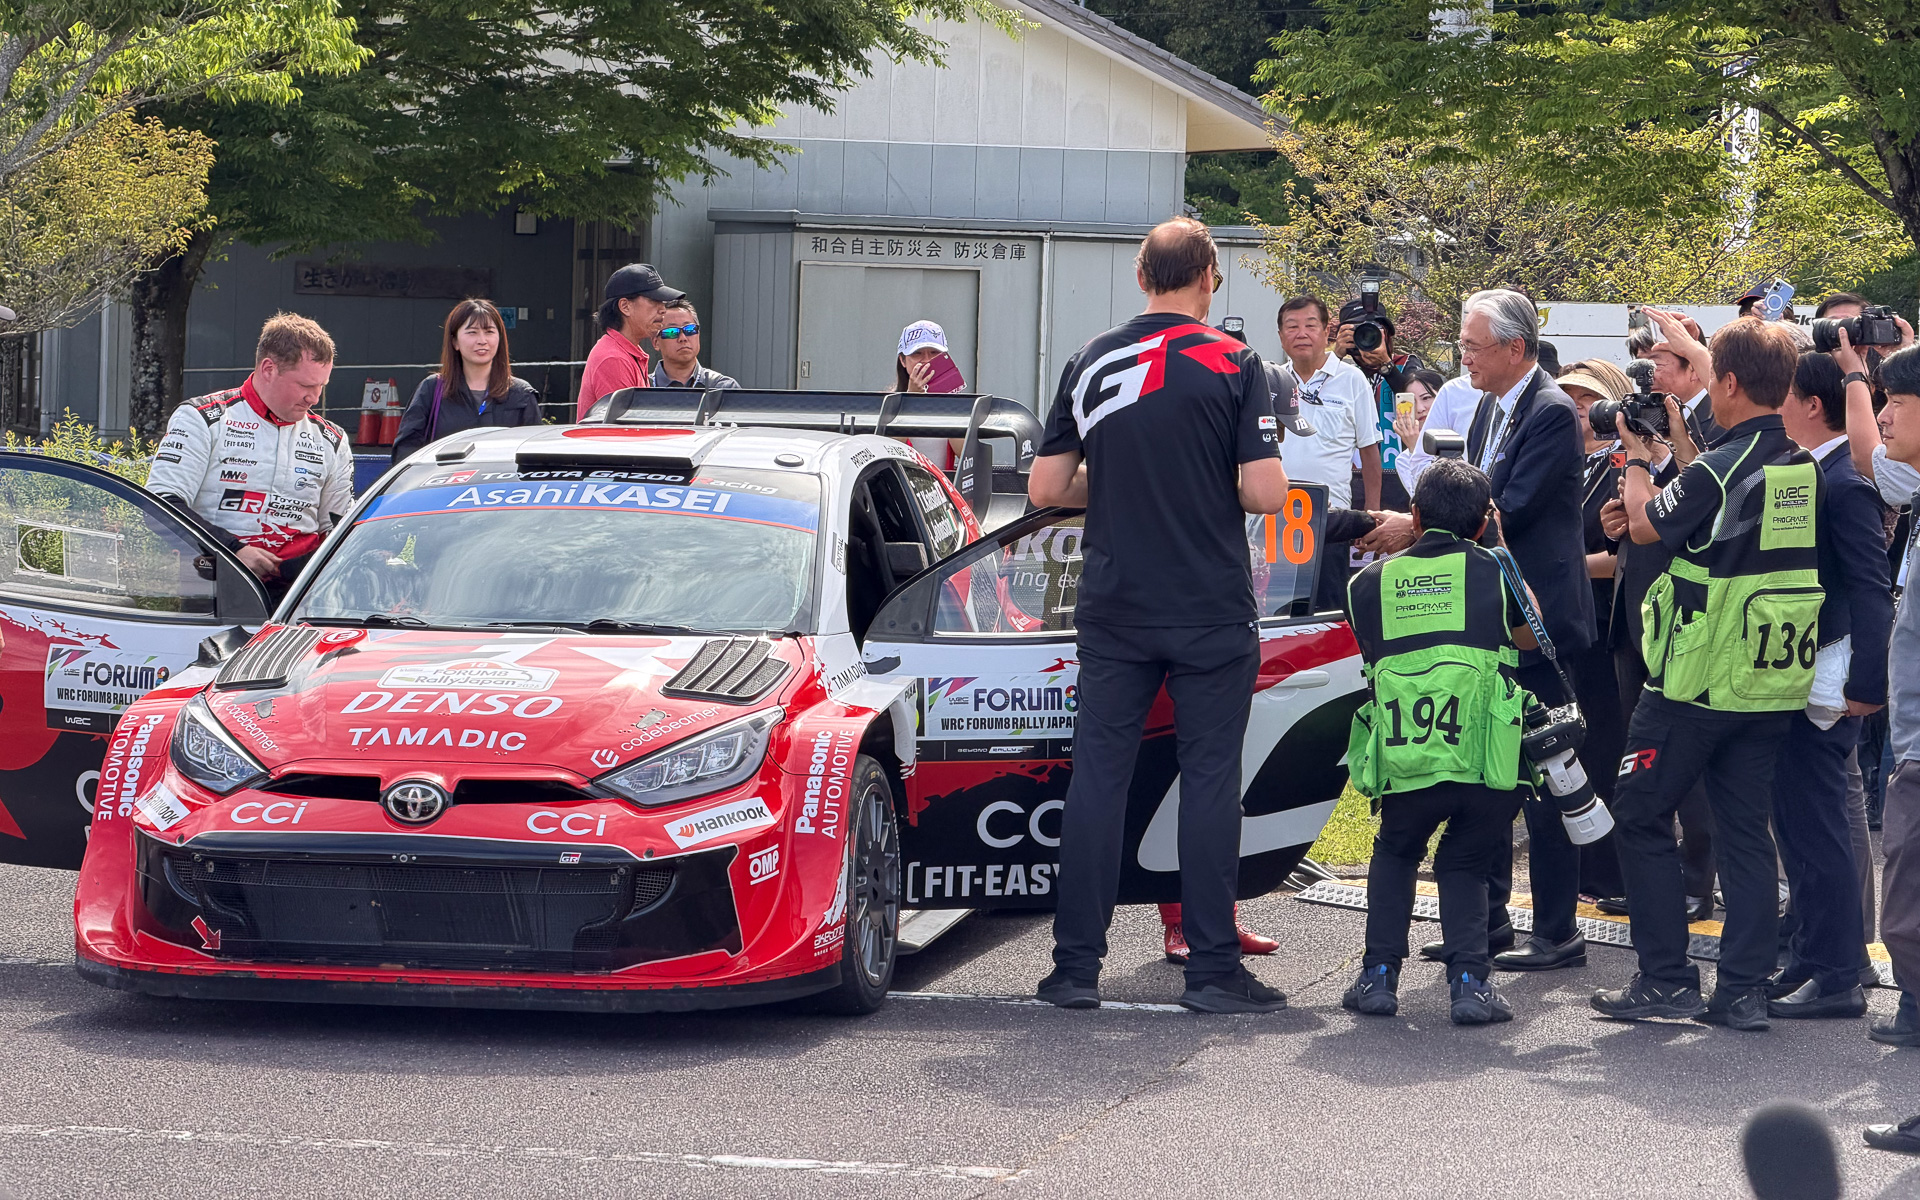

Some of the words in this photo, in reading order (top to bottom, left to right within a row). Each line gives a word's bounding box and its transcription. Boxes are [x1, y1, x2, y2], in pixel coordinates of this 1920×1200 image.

[811, 236, 942, 258] 和合自主防災会
[954, 241, 1027, 261] 防災倉庫
[1071, 323, 1249, 443] GR
[225, 419, 260, 430] DENSO
[226, 426, 255, 436] Panasonic
[1294, 417, 1309, 431] 18
[422, 473, 474, 487] GR
[481, 470, 583, 481] TOYOTA
[588, 470, 685, 483] GAZOO
[689, 477, 778, 495] Racing
[1774, 485, 1810, 500] WRC
[220, 497, 263, 513] GR
[265, 508, 303, 521] Racing
[272, 494, 312, 509] TOYOTA
[1264, 488, 1314, 565] 18
[1395, 573, 1452, 589] WRC
[1753, 621, 1816, 670] 136
[83, 661, 170, 691] FORUM8
[432, 668, 510, 677] FORUM8
[831, 660, 867, 691] TAMADIC
[57, 687, 76, 701] WRC
[77, 689, 112, 704] FORUM8
[112, 693, 141, 706] RALLY
[339, 691, 564, 719] DENSO
[973, 684, 1079, 713] FORUM8
[64, 716, 92, 726] WRC
[225, 703, 280, 752] codebeamer
[621, 705, 721, 752] codebeamer
[941, 717, 964, 731] WRC
[966, 717, 1011, 731] FORUM8
[1013, 717, 1046, 730] RALLY
[1383, 694, 1464, 747] 194
[348, 727, 527, 751] TAMADIC
[97, 714, 135, 822] AUTOMOTIVE
[117, 714, 165, 818] Panasonic
[1617, 748, 1657, 777] GR
[795, 729, 833, 834] Panasonic
[820, 728, 855, 839] AUTOMOTIVE
[230, 801, 308, 824] CCi
[526, 811, 608, 836] CCi
[976, 799, 1066, 849] CC
[749, 849, 780, 878] OMP
